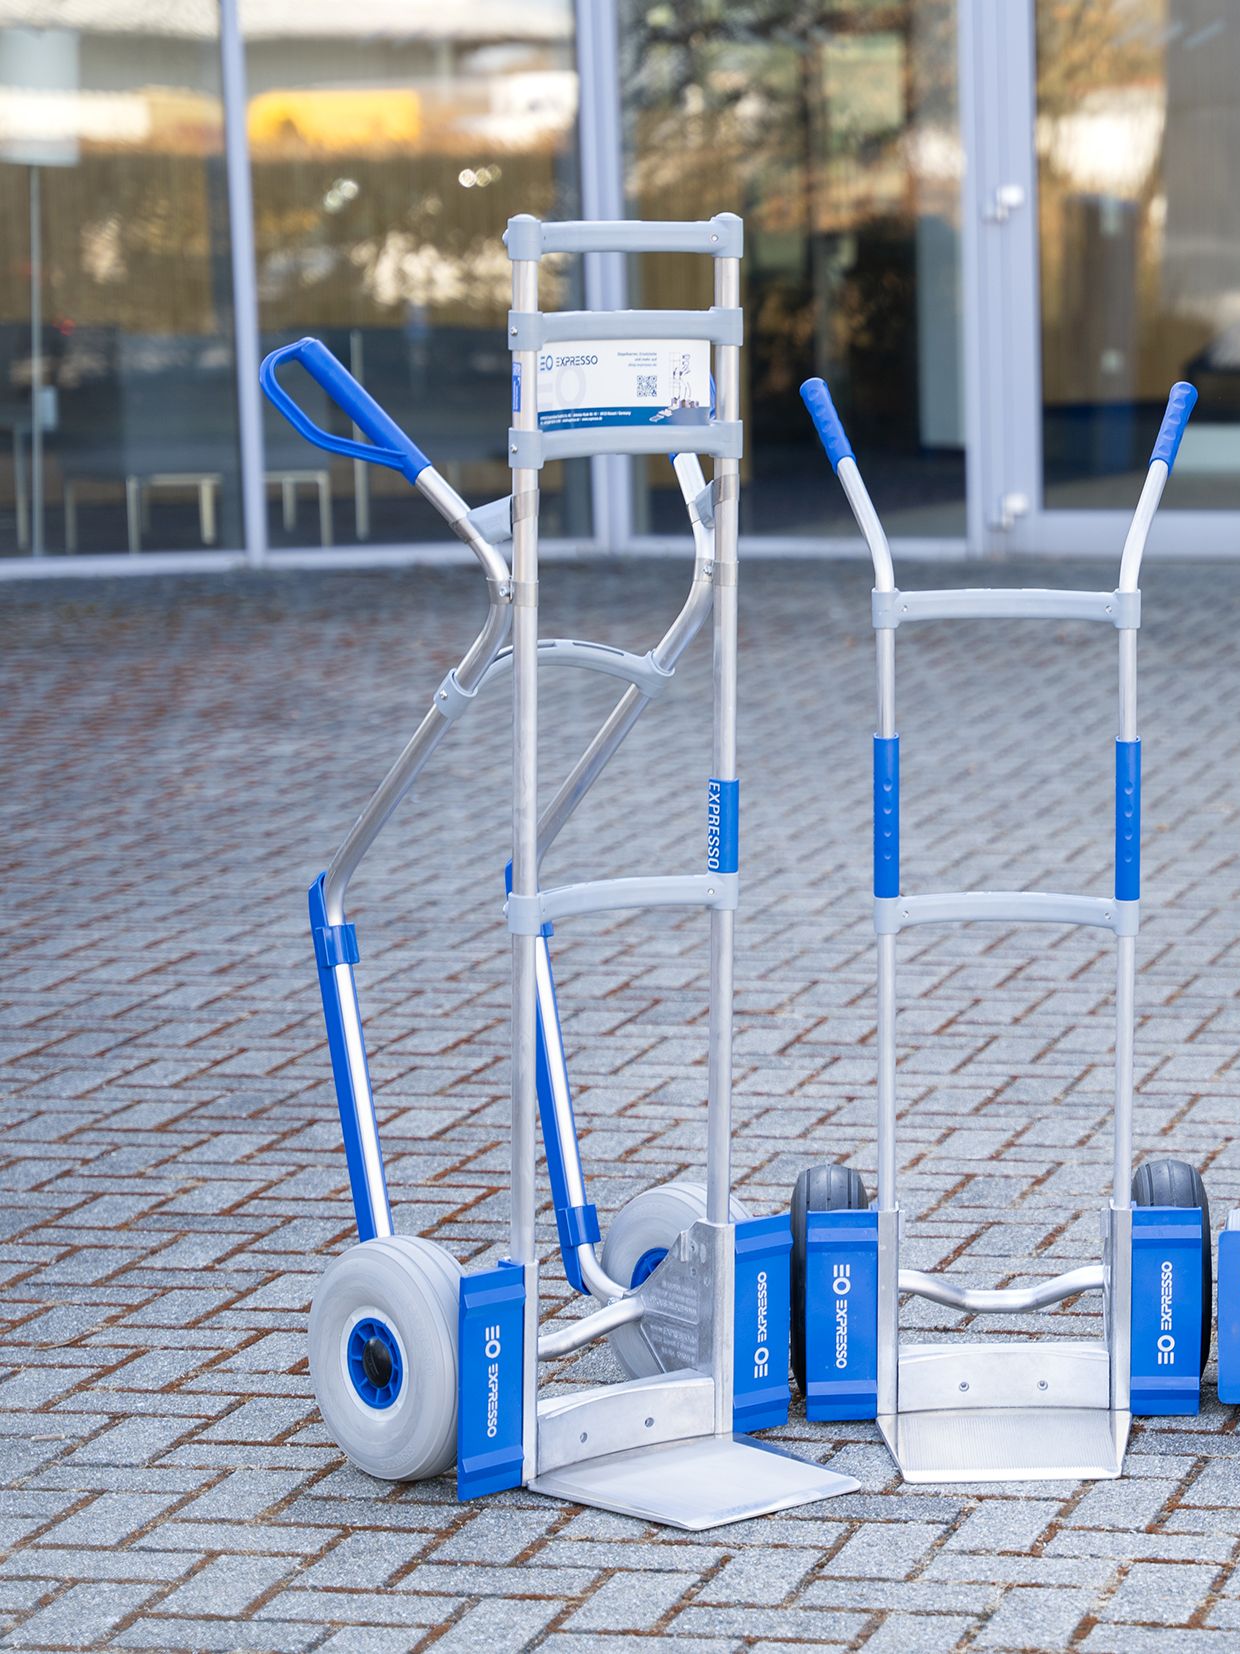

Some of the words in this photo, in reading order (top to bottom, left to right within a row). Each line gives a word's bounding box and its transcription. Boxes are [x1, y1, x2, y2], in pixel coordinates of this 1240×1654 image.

[555, 354, 598, 367] EXPRESSO
[708, 781, 721, 870] EXPRESSO
[757, 1271, 768, 1343] EXPRESSO
[1160, 1261, 1173, 1331] EXPRESSO
[835, 1299, 848, 1369] EXPRESSO
[486, 1363, 499, 1438] EXPRESSO
